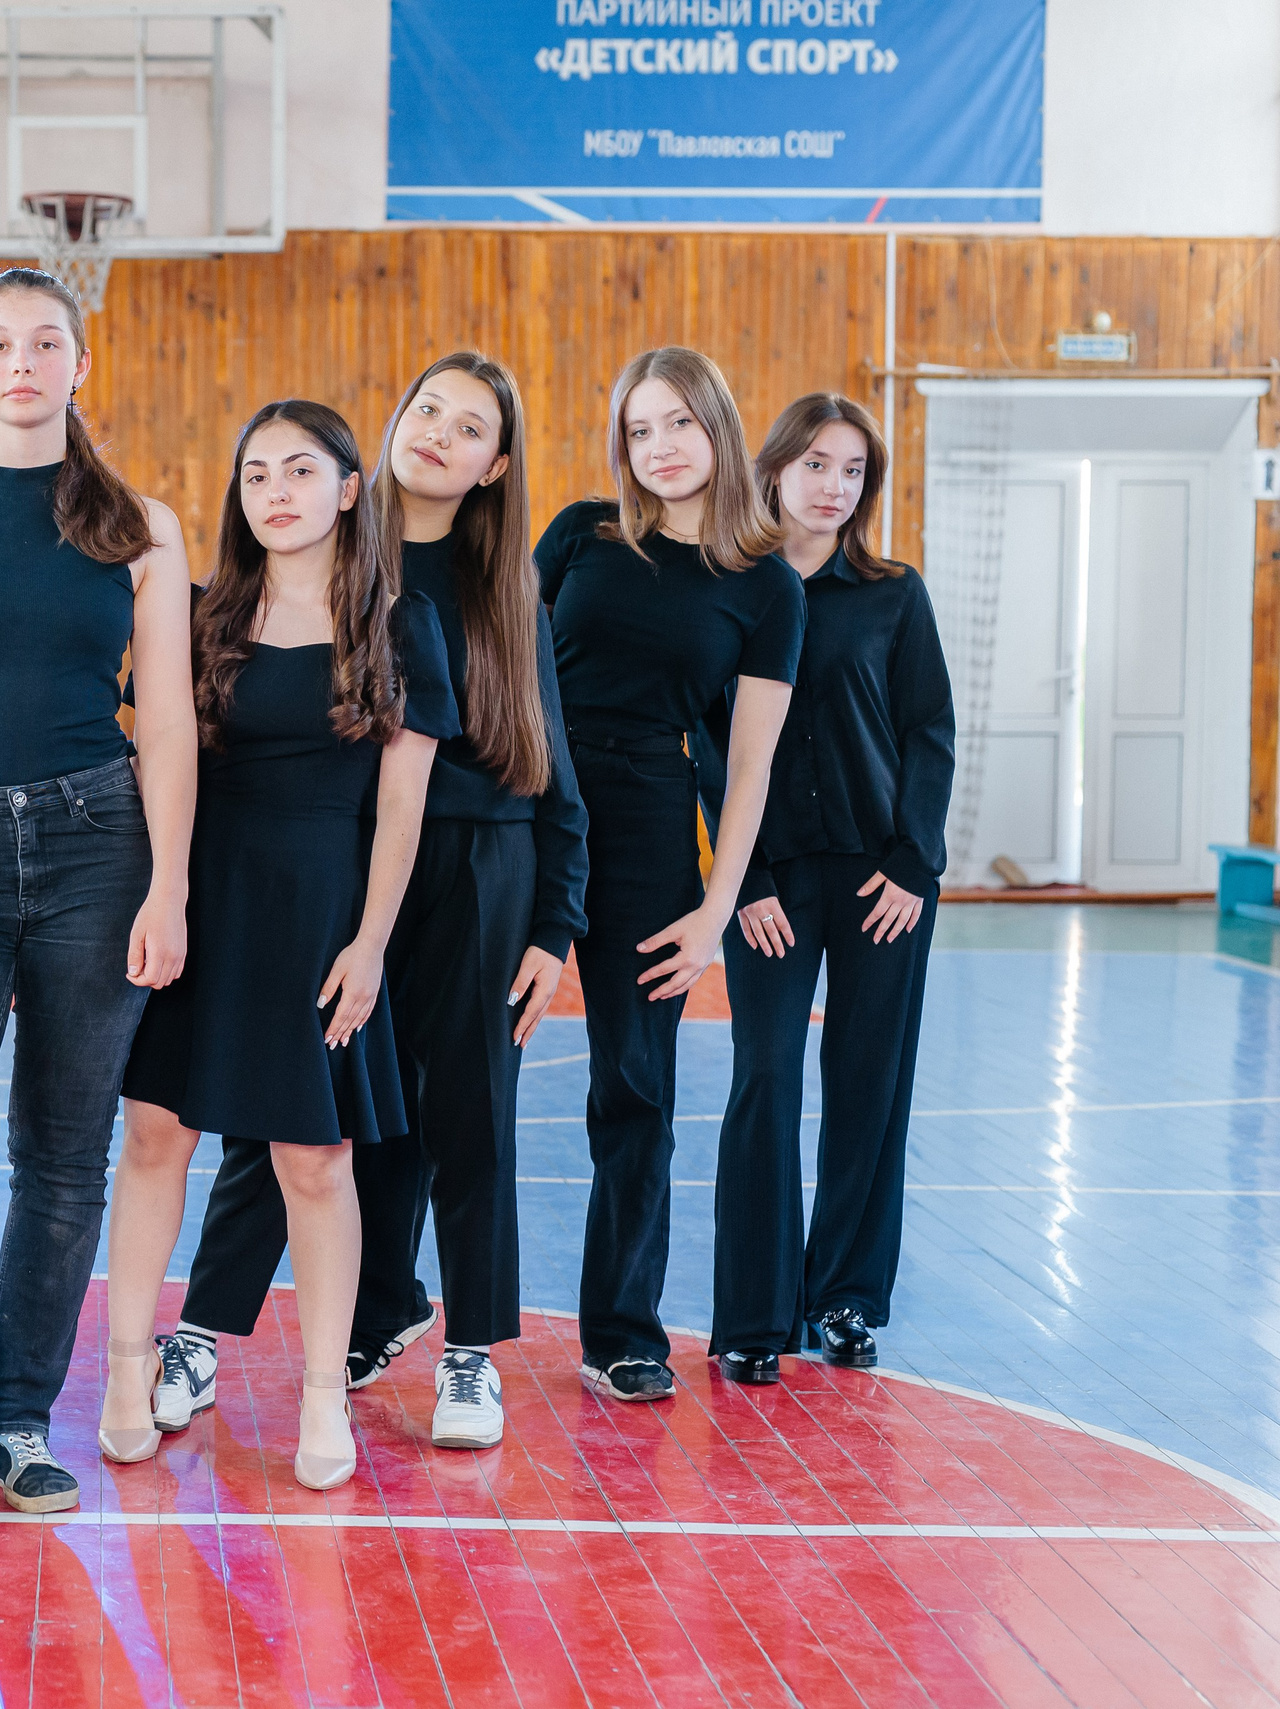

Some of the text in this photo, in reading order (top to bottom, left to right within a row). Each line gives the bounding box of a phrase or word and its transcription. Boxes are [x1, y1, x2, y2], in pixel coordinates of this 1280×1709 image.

[759, 0, 882, 27] ПРОЕКТ
[534, 30, 899, 81] «ДЕТСКИЙ СПОРТ»
[583, 129, 644, 158] МБОУ
[784, 129, 846, 158] СОШ"
